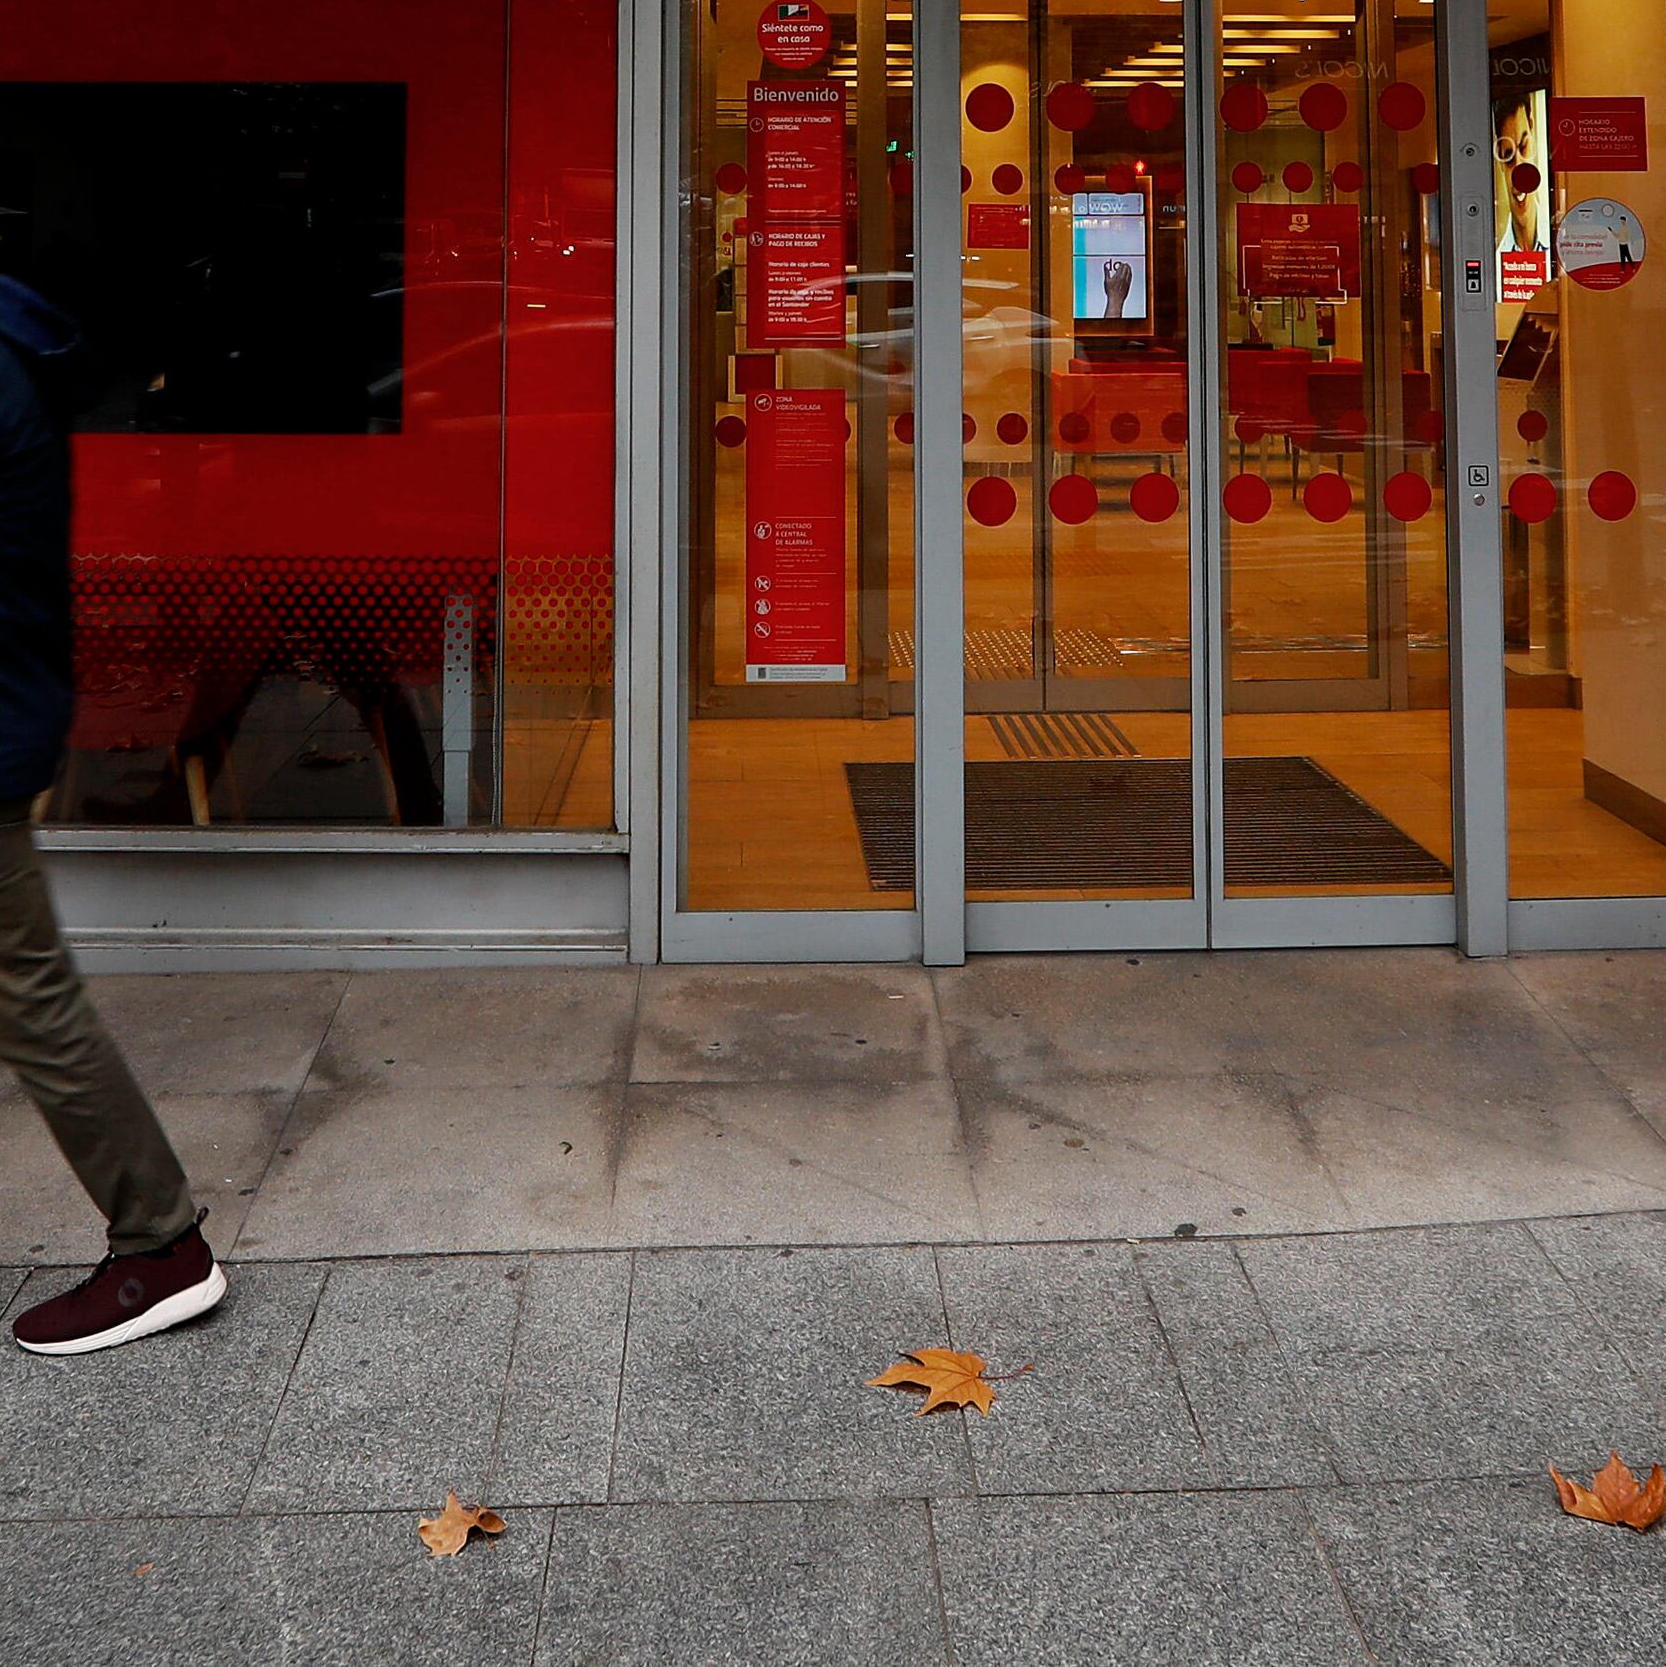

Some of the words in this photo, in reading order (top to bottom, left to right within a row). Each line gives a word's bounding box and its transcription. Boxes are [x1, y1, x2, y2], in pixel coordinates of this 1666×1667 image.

[762, 23, 798, 33] Siéntete
[777, 35, 788, 43] en
[790, 35, 810, 43] casa
[754, 87, 839, 102] Bienvenido
